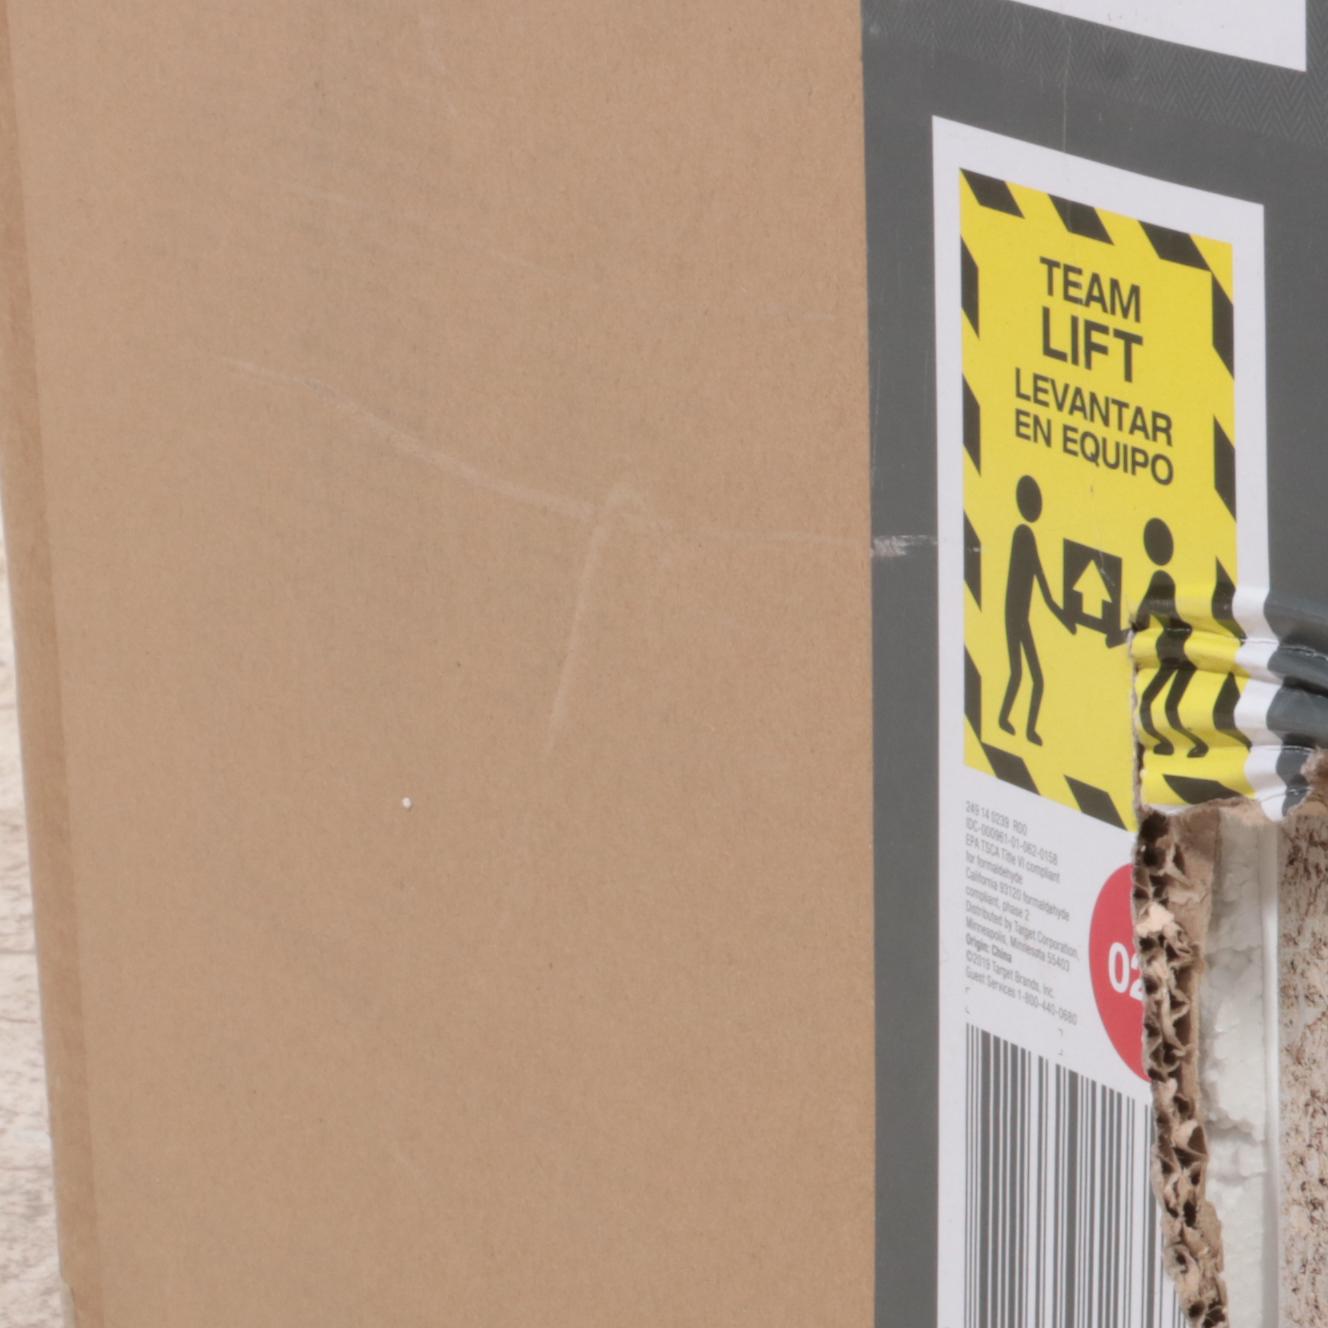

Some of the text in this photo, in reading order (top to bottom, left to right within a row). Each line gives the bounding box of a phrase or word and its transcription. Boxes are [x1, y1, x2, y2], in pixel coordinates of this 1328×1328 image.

[1040, 256, 1141, 323] TEAM
[1042, 305, 1143, 383] LIFT
[1015, 367, 1173, 447] LEVANTAR
[1015, 408, 1174, 486] EN EQUIPO
[966, 833, 1060, 883] EPA TSCA Title VI compliant
[966, 850, 1022, 885] for formaldehyde
[966, 866, 1070, 921] California 93120 formaldehyde
[966, 886, 1000, 909] compliant,
[1002, 901, 1023, 918] phase
[966, 900, 1002, 925] Distributed
[1005, 916, 1012, 932] by
[1015, 920, 1035, 940] Target
[966, 916, 1070, 972] Minneapolis, Minnesota 55403
[966, 933, 1012, 963] Origin: China
[966, 966, 985, 983] Guest
[987, 975, 1016, 998] Services
[993, 961, 1013, 980] Target
[1015, 971, 1040, 993] Brands,
